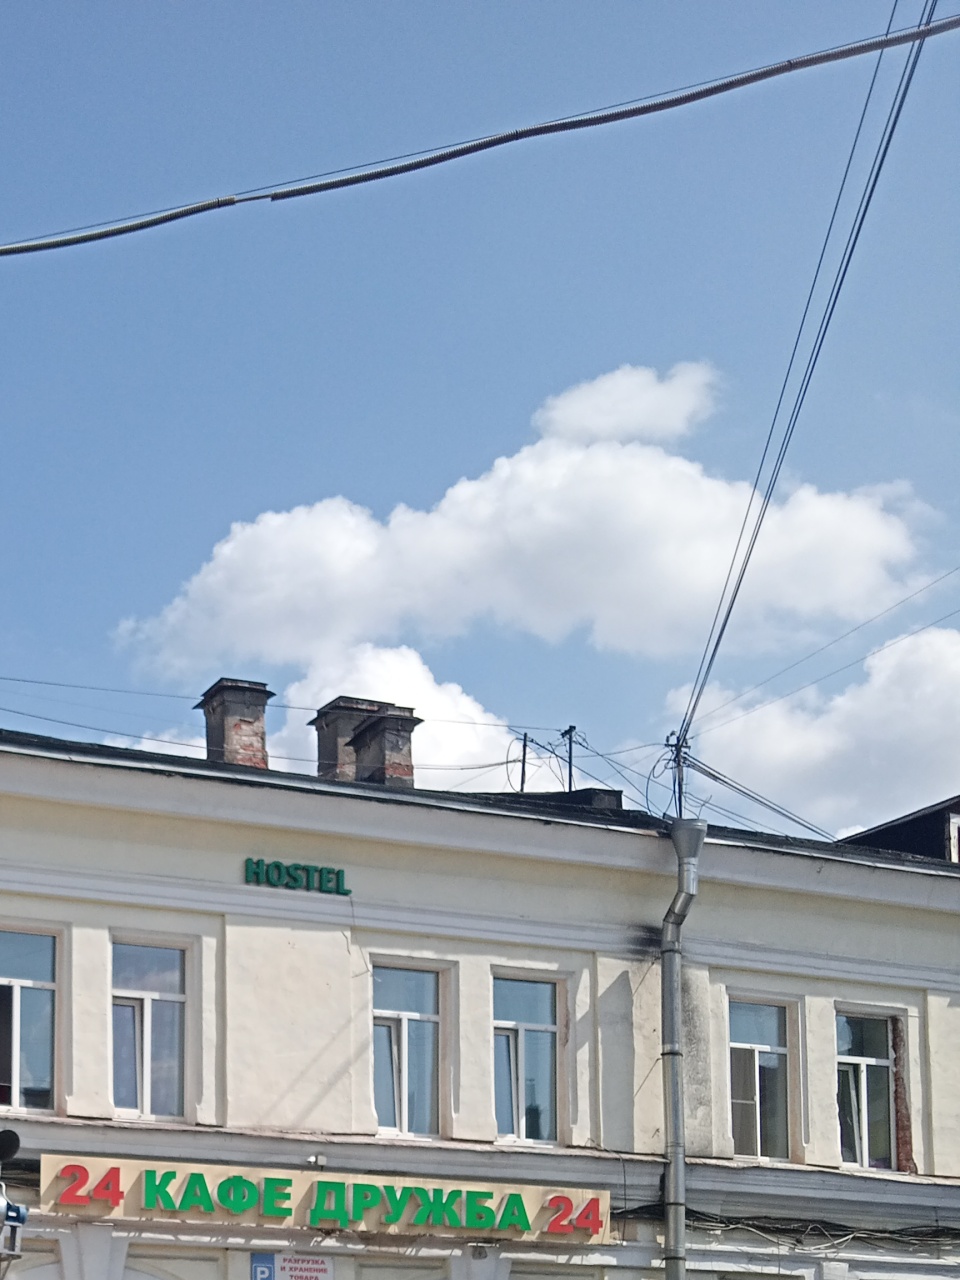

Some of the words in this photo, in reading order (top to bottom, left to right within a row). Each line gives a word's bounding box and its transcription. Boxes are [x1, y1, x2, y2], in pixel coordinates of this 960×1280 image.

[244, 858, 352, 895] HOSTEL
[58, 1164, 124, 1207] 24
[142, 1169, 293, 1217] КАФЕ
[308, 1179, 532, 1231] ДРУЖБА
[547, 1195, 604, 1235] 24
[282, 1257, 326, 1265] РАЗГРУЗКА
[288, 1266, 328, 1274] ХРАНЕНИЕ
